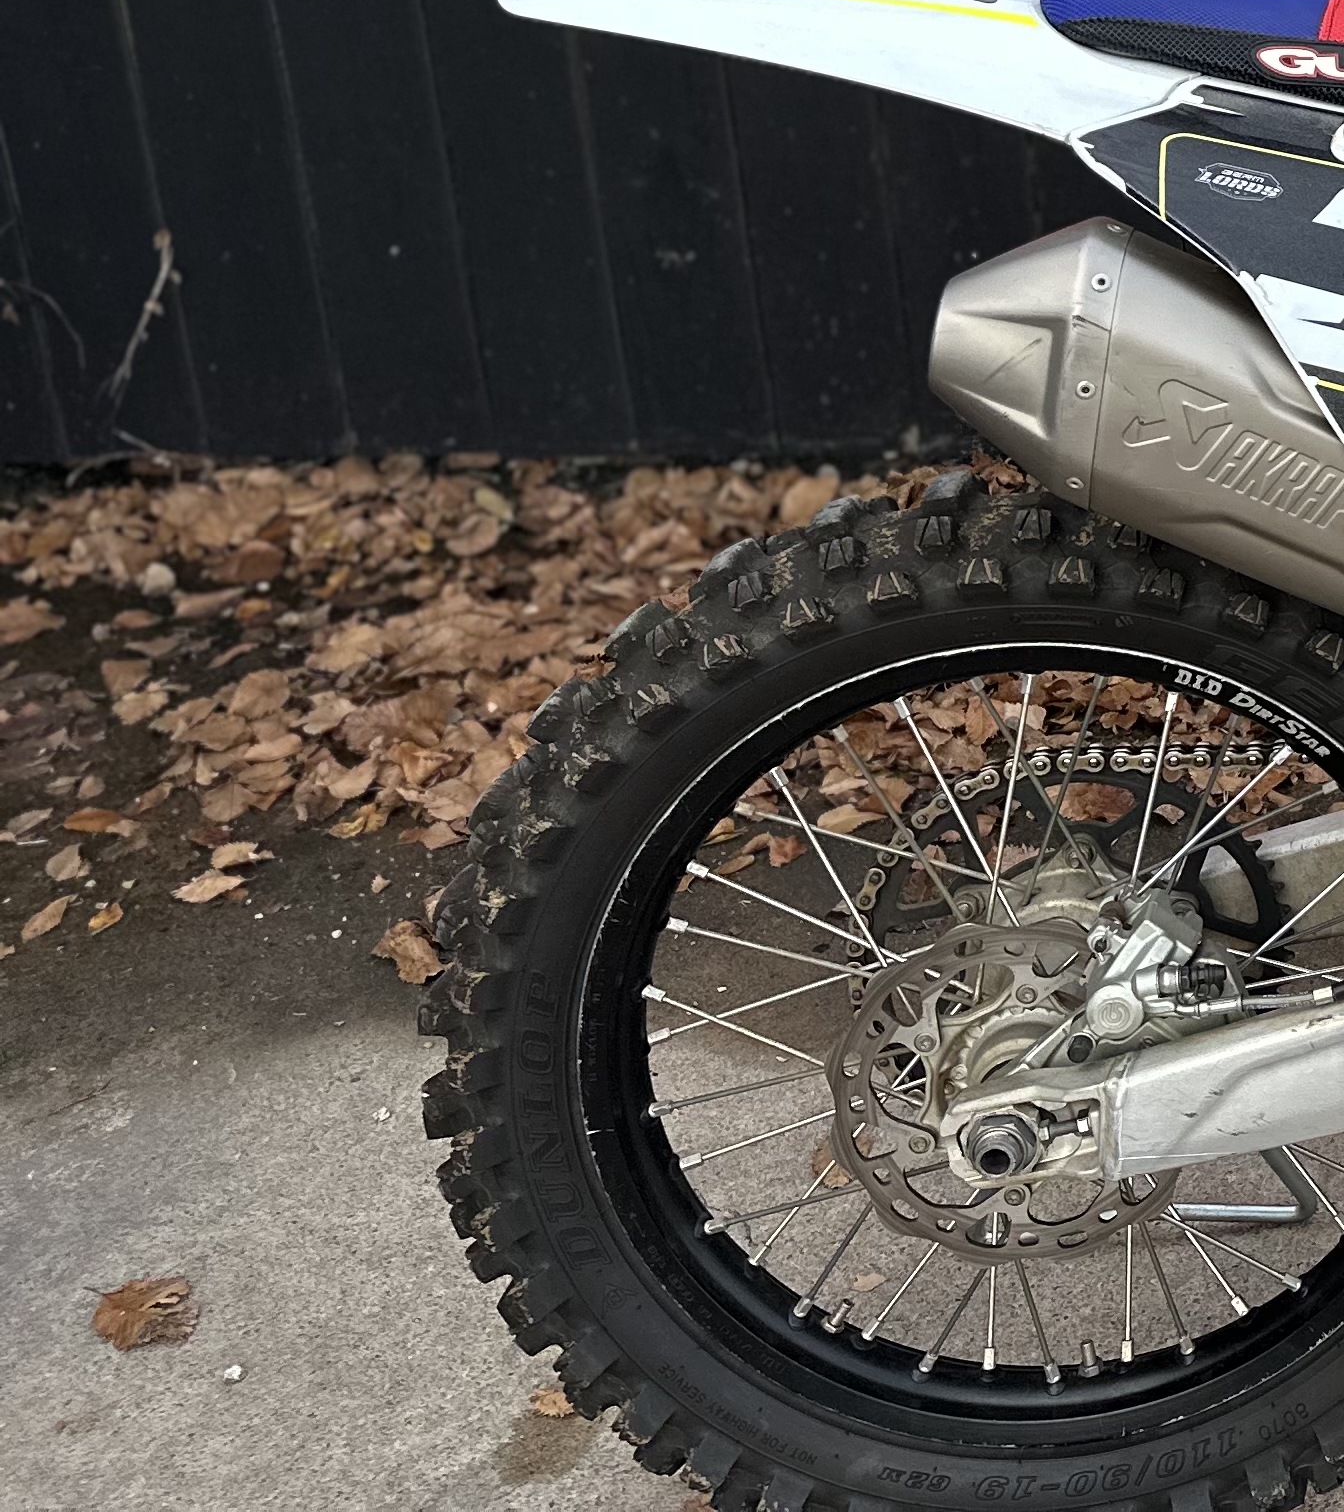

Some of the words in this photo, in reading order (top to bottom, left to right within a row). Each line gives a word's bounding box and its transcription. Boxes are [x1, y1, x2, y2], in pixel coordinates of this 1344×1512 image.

[1198, 171, 1281, 197] LORDS
[517, 968, 613, 1271] DUNLOP
[656, 1361, 707, 1405] SERVICE
[760, 1432, 789, 1454] FOR
[1255, 1400, 1309, 1443] 8070
[789, 1445, 819, 1468] NOT
[973, 1426, 1244, 1504] 110/90-19
